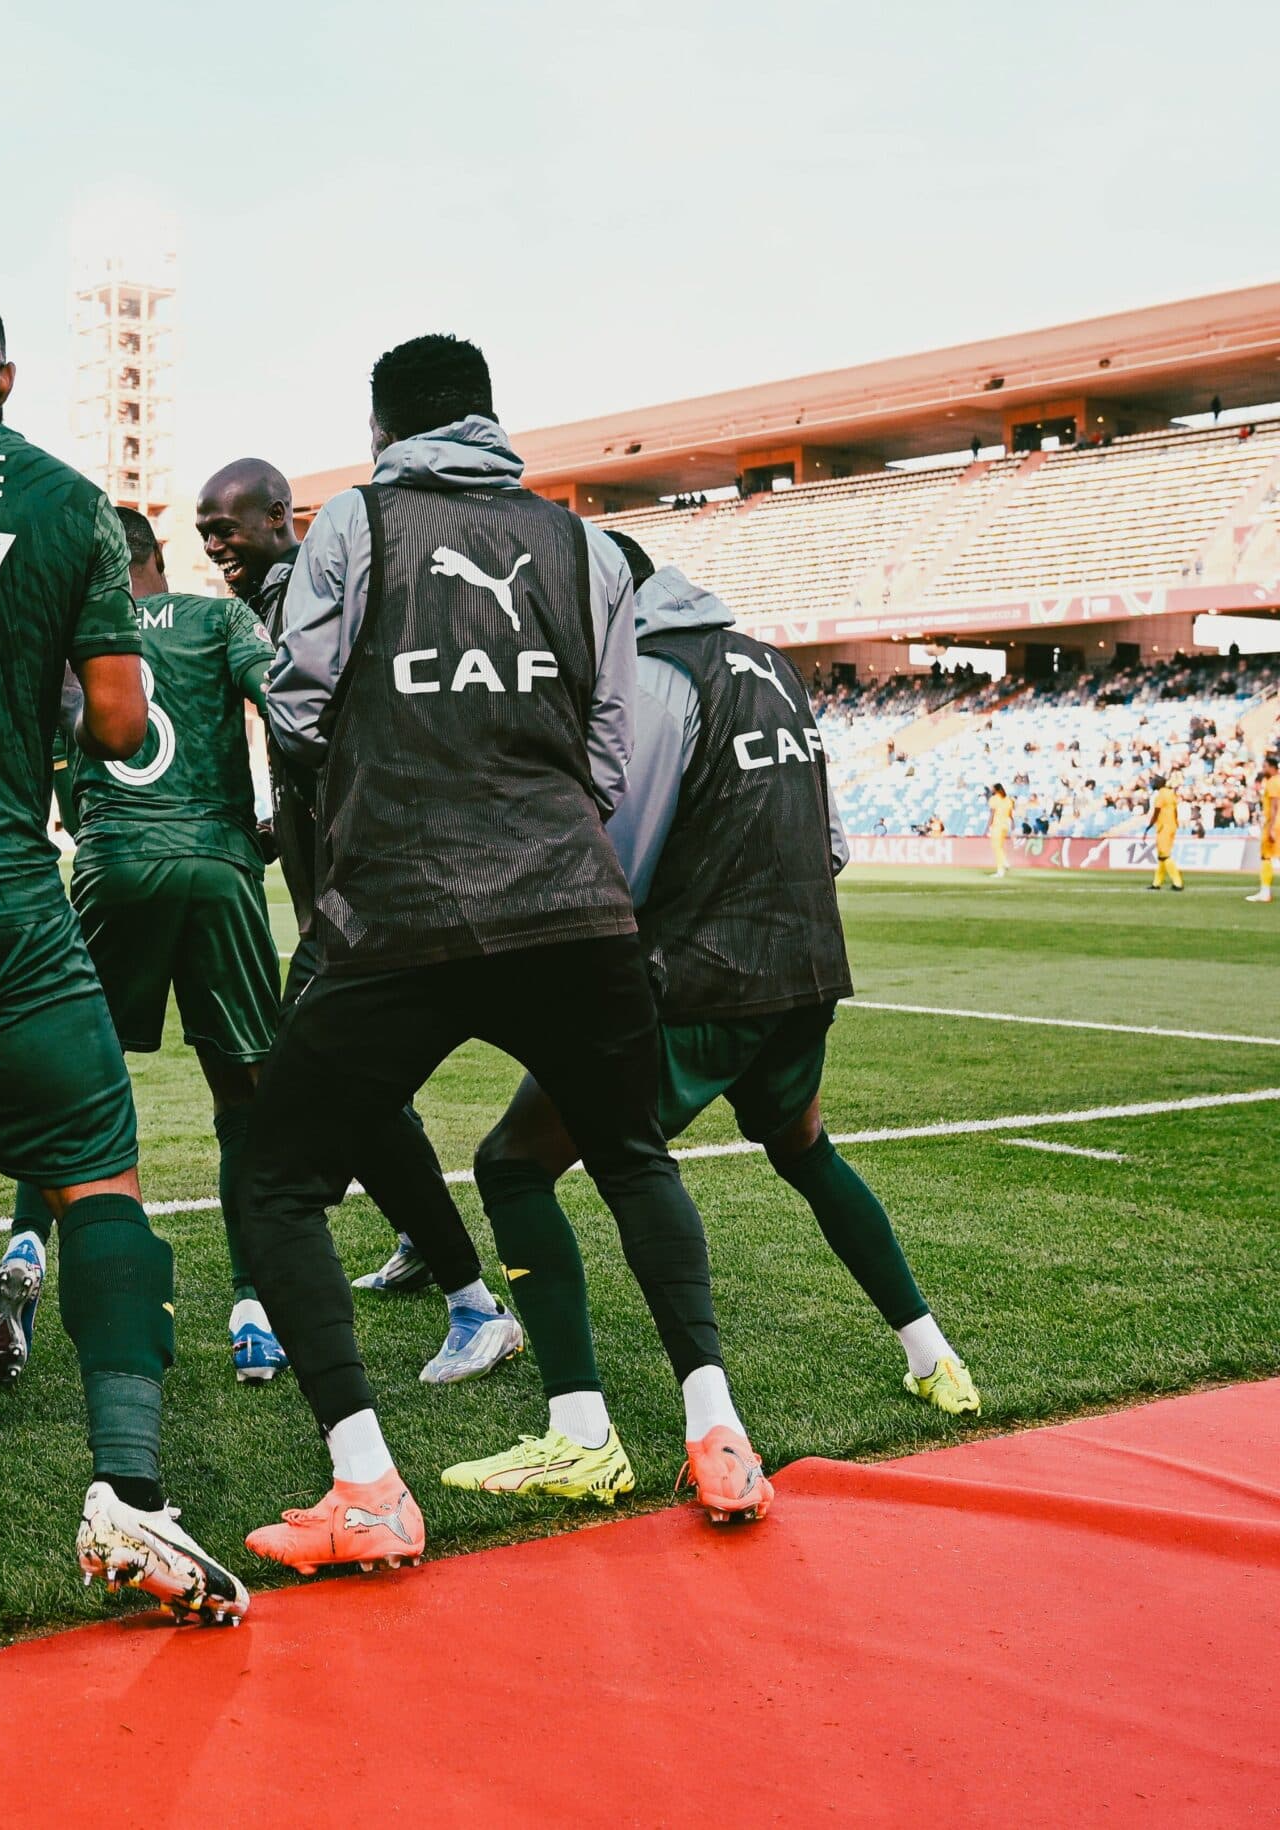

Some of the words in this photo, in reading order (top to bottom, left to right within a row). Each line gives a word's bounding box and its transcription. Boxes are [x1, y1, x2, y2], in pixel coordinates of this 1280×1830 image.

[392, 647, 560, 695] CAF
[732, 727, 824, 771] CAF
[1126, 841, 1220, 866] 1XET
